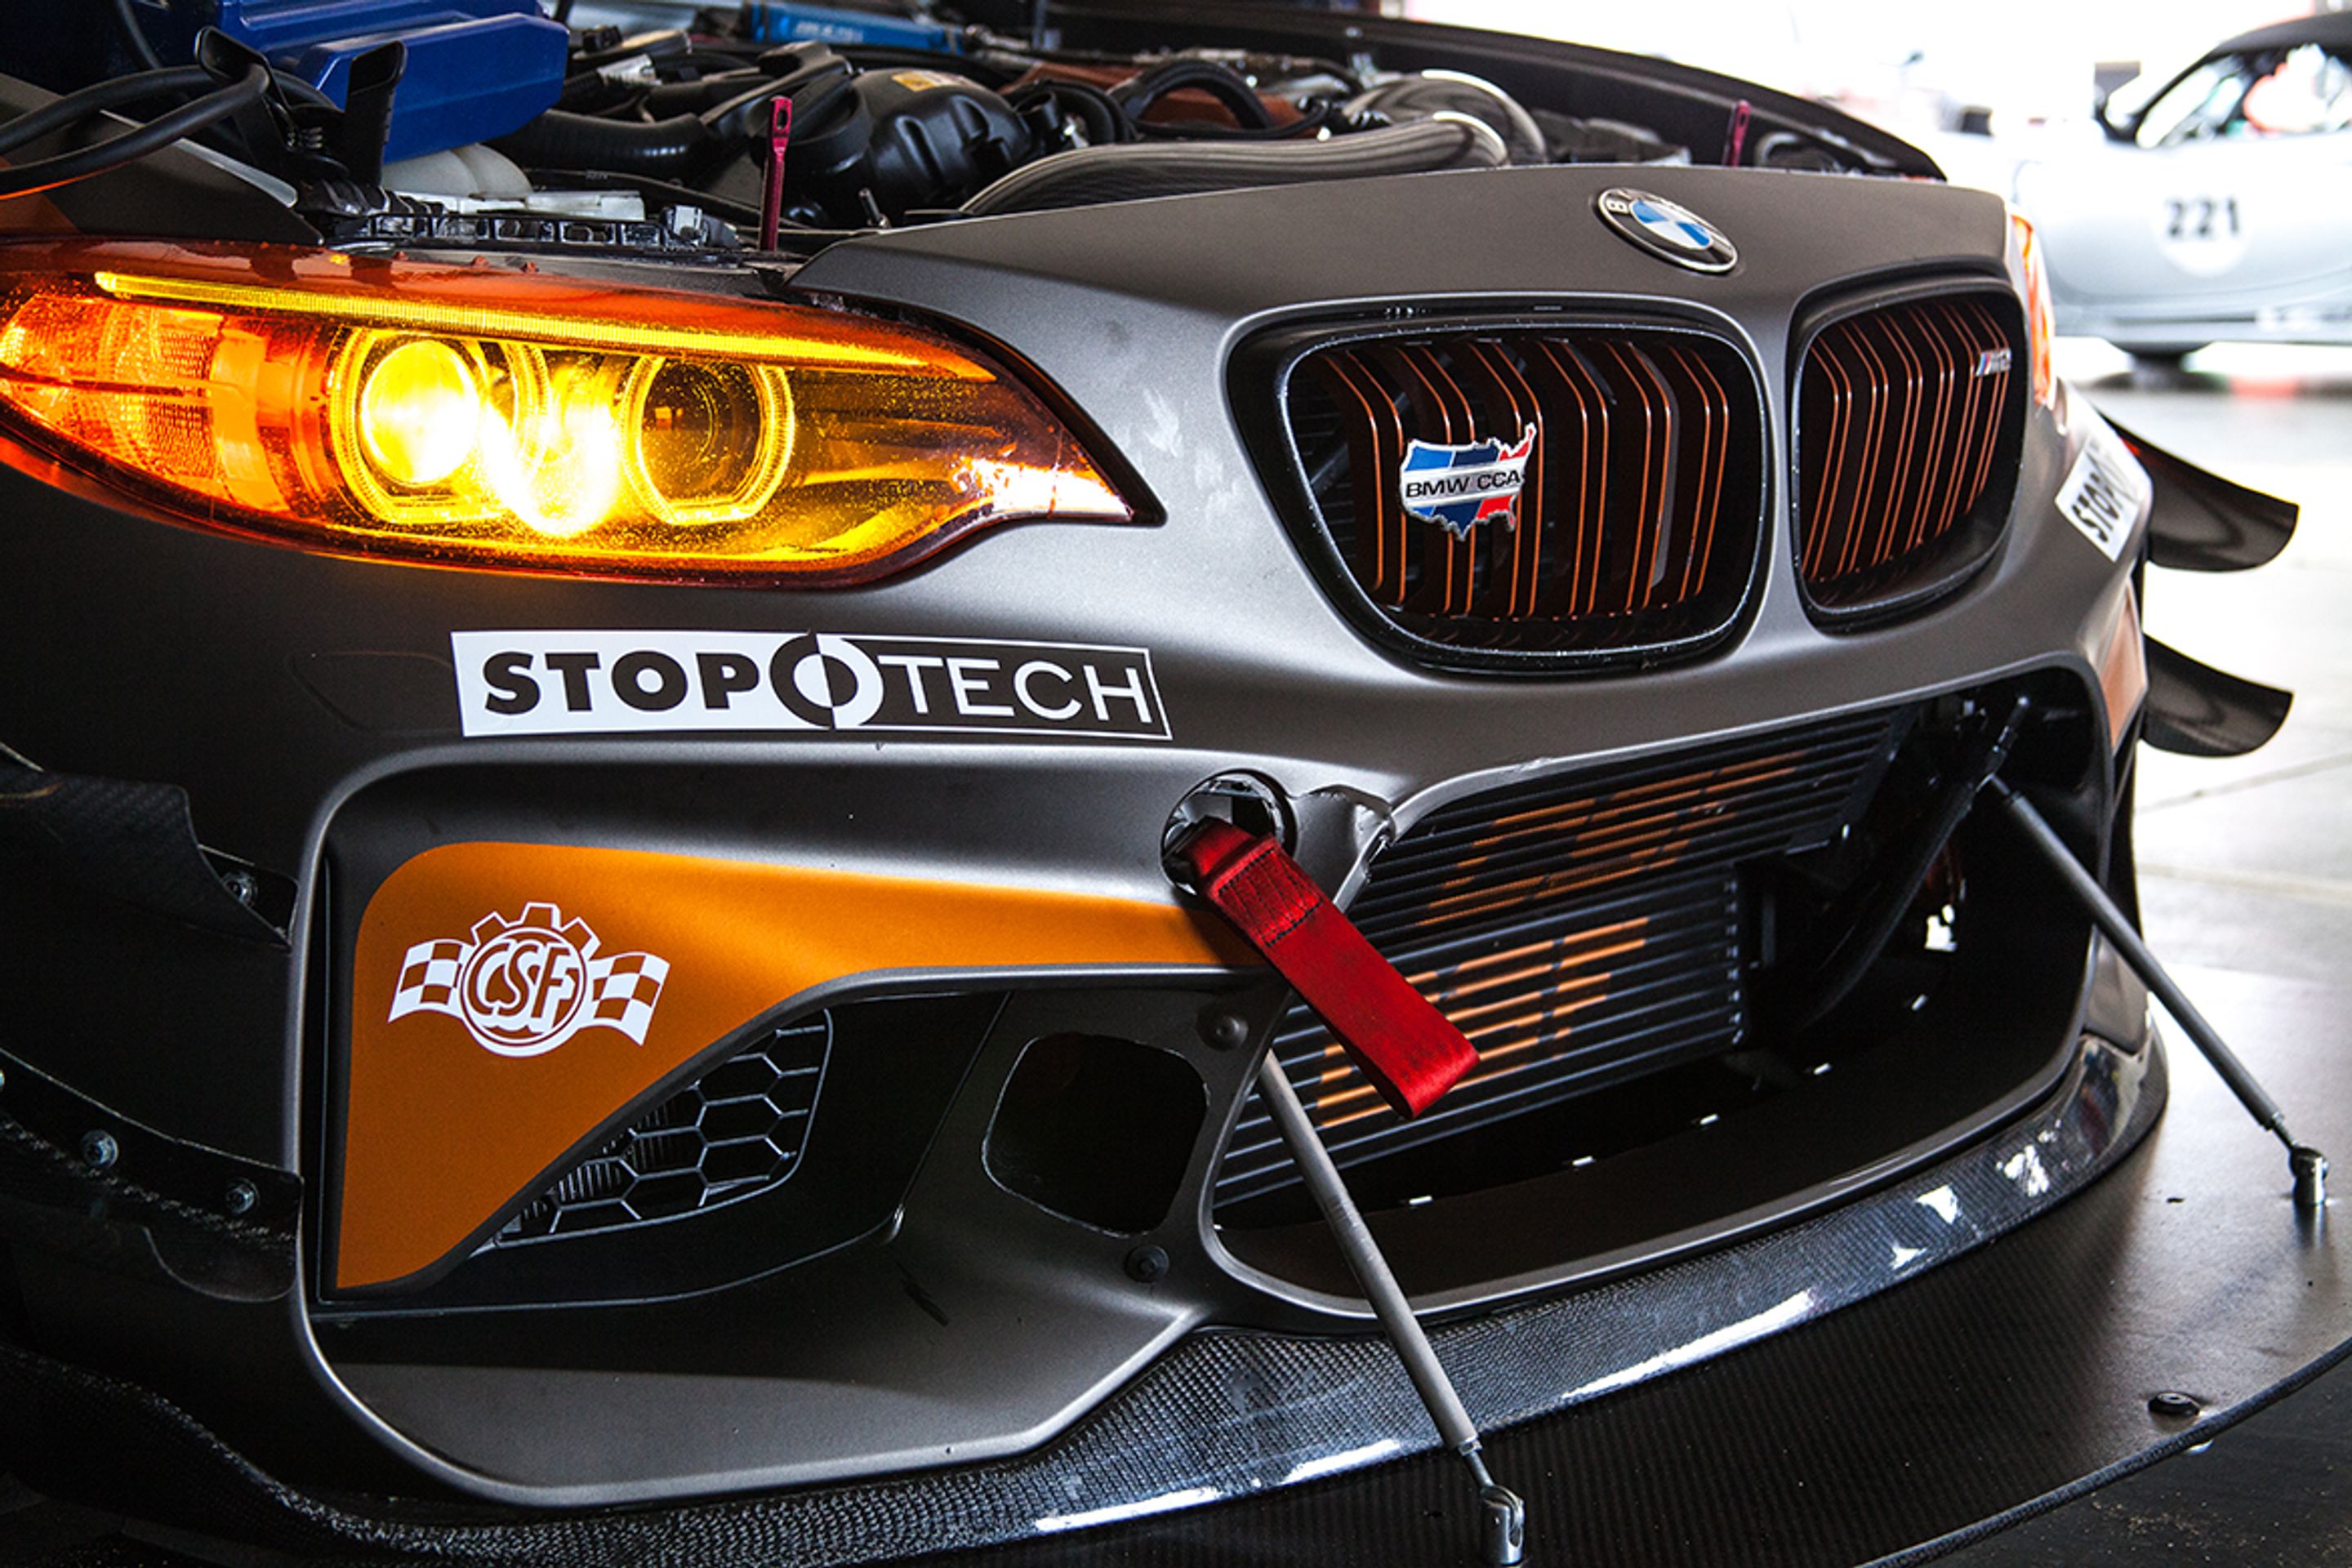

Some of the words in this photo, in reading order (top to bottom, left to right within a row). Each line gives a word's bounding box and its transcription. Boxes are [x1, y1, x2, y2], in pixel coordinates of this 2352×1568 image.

[2165, 197, 2239, 238] 221
[1405, 476, 1470, 497] BMW
[1477, 470, 1521, 490] CCA
[466, 941, 575, 1021] CSF
